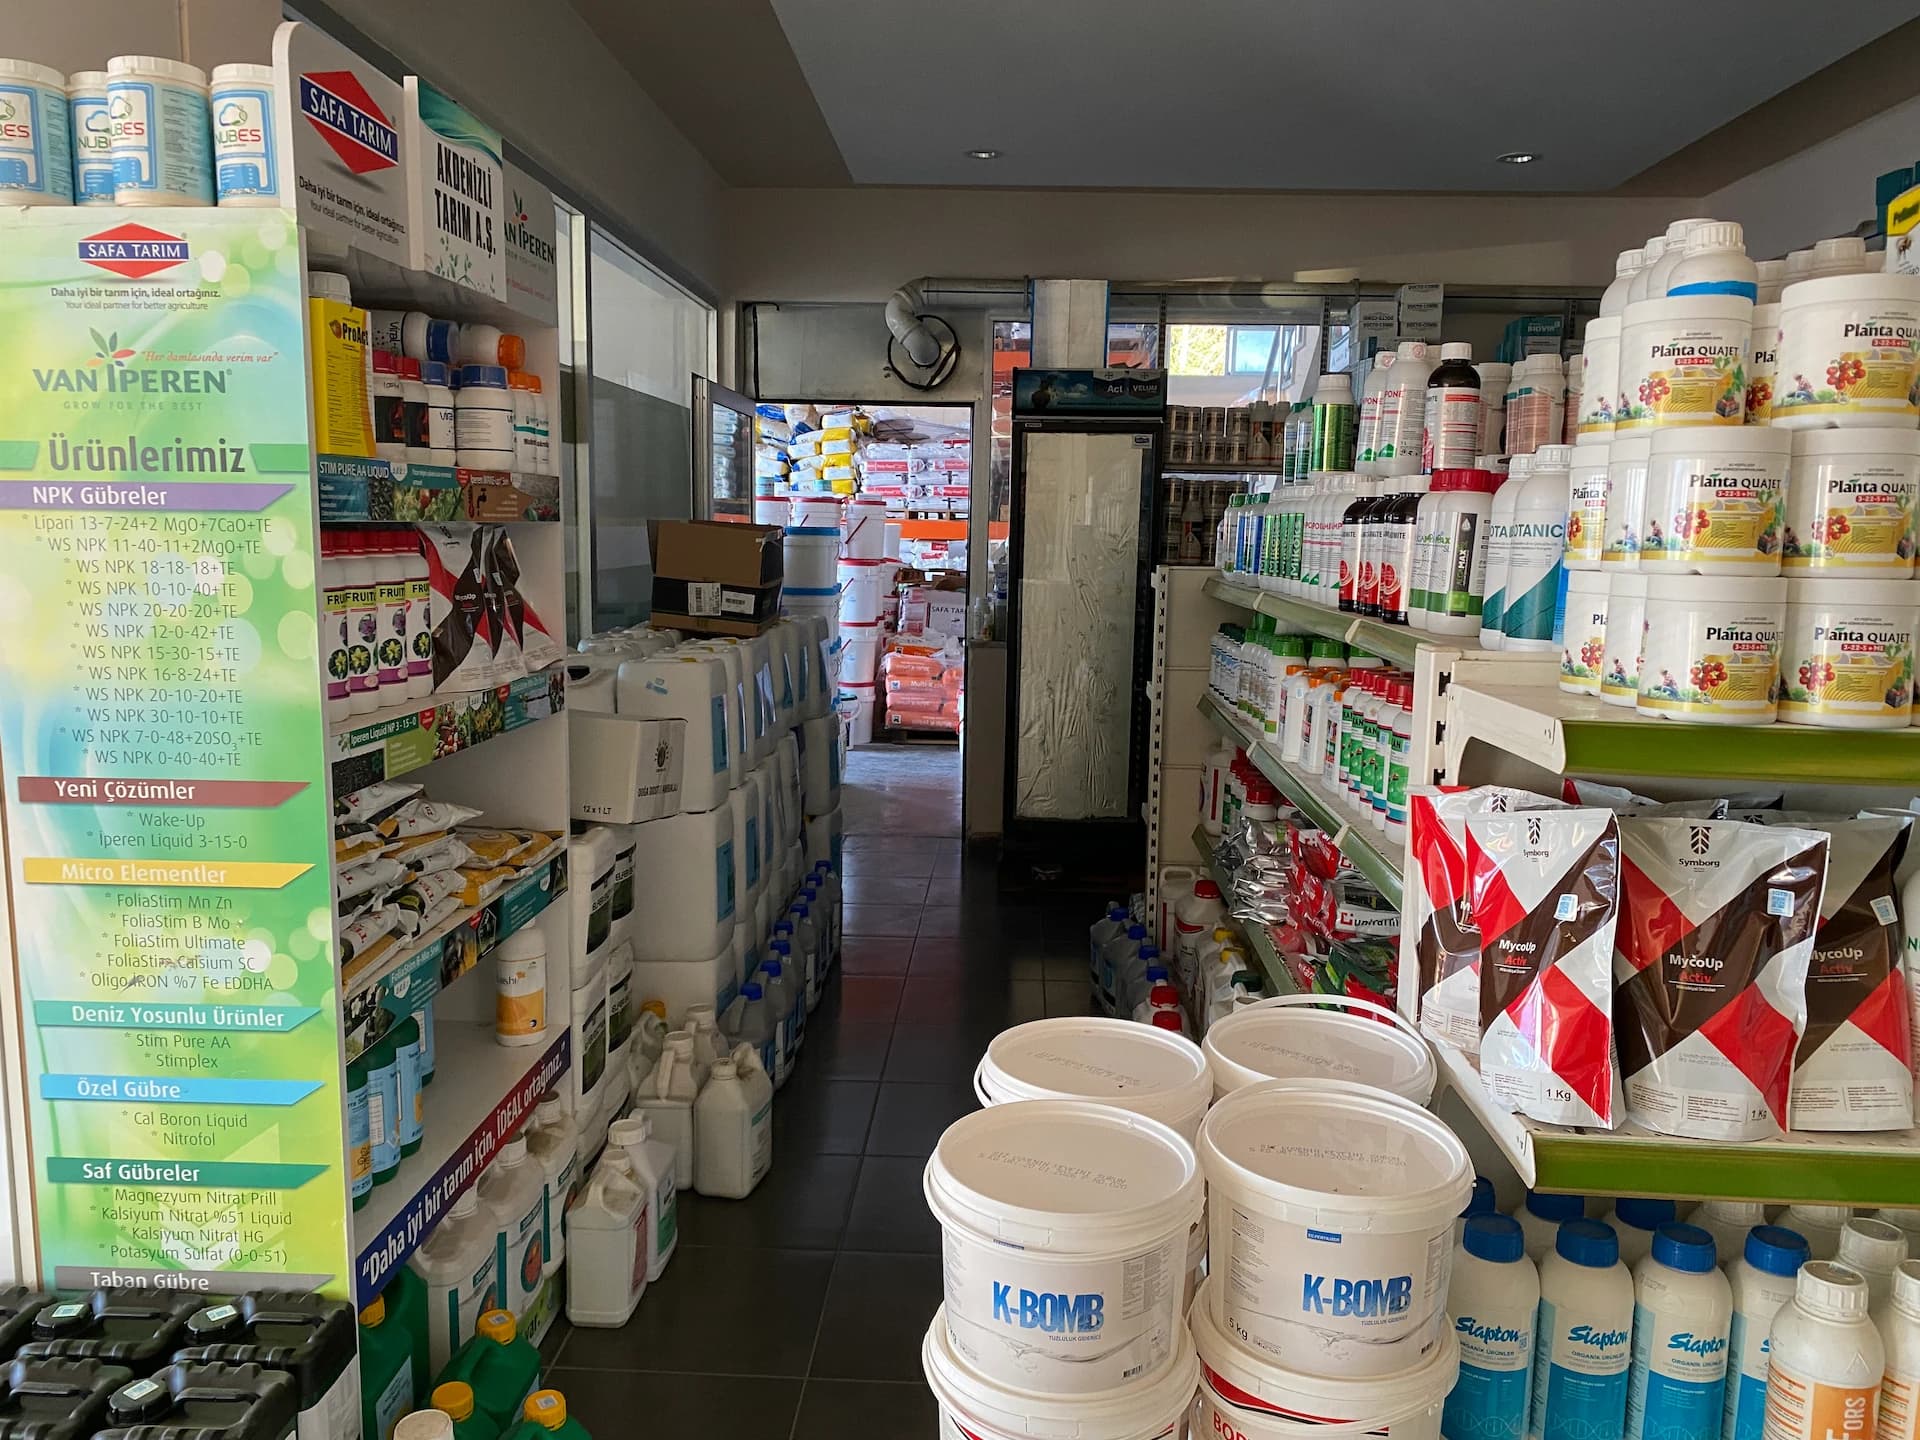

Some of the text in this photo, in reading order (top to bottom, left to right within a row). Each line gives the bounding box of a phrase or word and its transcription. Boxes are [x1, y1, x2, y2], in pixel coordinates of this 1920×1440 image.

[310, 87, 392, 154] SAFA TARIM
[437, 142, 492, 209] AKDENİZLİ
[435, 188, 471, 243] TARIM
[476, 211, 495, 259] A.Ş.
[88, 245, 180, 258] SAFA TARIM
[52, 288, 75, 297] Daha
[77, 289, 88, 298] iyi
[90, 289, 102, 297] bir
[152, 289, 174, 297] ideal
[176, 290, 221, 299] ortağınız.
[143, 302, 166, 310] better
[168, 302, 208, 311] agriculture
[1844, 322, 1892, 337] Planta
[225, 353, 254, 362] verim
[1652, 344, 1739, 358] Planta QUAJET
[32, 369, 98, 392] VAN
[1107, 385, 1122, 393] Act
[49, 432, 245, 473] Ürünlerimiz
[320, 462, 389, 479] STIM PURE AA LIQUID
[1690, 474, 1781, 489] Planta QUAJET
[1828, 479, 1918, 494] Planta QUAJET
[33, 486, 167, 506] NPK Gübreler
[34, 515, 272, 534] Lipari 13-7-24+2 MgO+7CaO+TE
[48, 538, 261, 557] WS NPK 11-40-11+2MgO+TE
[77, 560, 236, 575] WS NPK 18-18-18+TE
[1707, 627, 1752, 640] Planta
[1814, 627, 1910, 644] Planta QUAJET
[369, 723, 387, 741] Liquid
[95, 750, 241, 766] WS NPK 0-40-40+TE
[55, 781, 195, 802] Yeni Çözümler
[139, 813, 205, 830] Wake-Up
[151, 834, 193, 850] Liquid
[199, 835, 247, 848] 3-15-0
[1679, 858, 1720, 868] Symborg
[62, 864, 228, 883] Micro Elementler
[117, 894, 232, 909] FoliaStim Mn Zn
[114, 934, 246, 950] FoliaStim Ultimate
[1499, 940, 1536, 954] MycoUp
[238, 957, 255, 970] SC
[1670, 954, 1724, 971] MycoUp
[92, 973, 274, 990] Oligo %7 Fe EDDHA
[1679, 970, 1712, 984] Activ
[72, 1006, 284, 1026] Deniz Yosunlu Ürünler
[136, 1034, 231, 1049] Stim Pure AA
[156, 1054, 218, 1069] Stimplex
[77, 1077, 181, 1097] Özel Gübre
[1546, 1089, 1571, 1101] 1 Kg
[134, 1112, 248, 1130] Cal Boron Liquid
[163, 1132, 215, 1146] Nitrofol
[83, 1163, 200, 1182] Saf Gübreler
[115, 1189, 277, 1205] Magnezyum Nitrat Prill
[407, 1202, 422, 1246] iyi
[425, 1186, 441, 1223] bir
[443, 1153, 473, 1200] tarım
[475, 1131, 495, 1167] için,
[102, 1208, 292, 1227] Kalsiyum Nitrat %51 Liquid
[111, 1245, 287, 1264] Potasyum Sülfat (0-0-51)
[91, 1272, 209, 1290] Taban Gübre
[1302, 1273, 1412, 1318] K-BOMB
[993, 1280, 1104, 1333] K-BOMB
[1229, 1317, 1248, 1341] 5 kg
[1456, 1317, 1519, 1344] Siapton
[1568, 1325, 1628, 1349] Siapton
